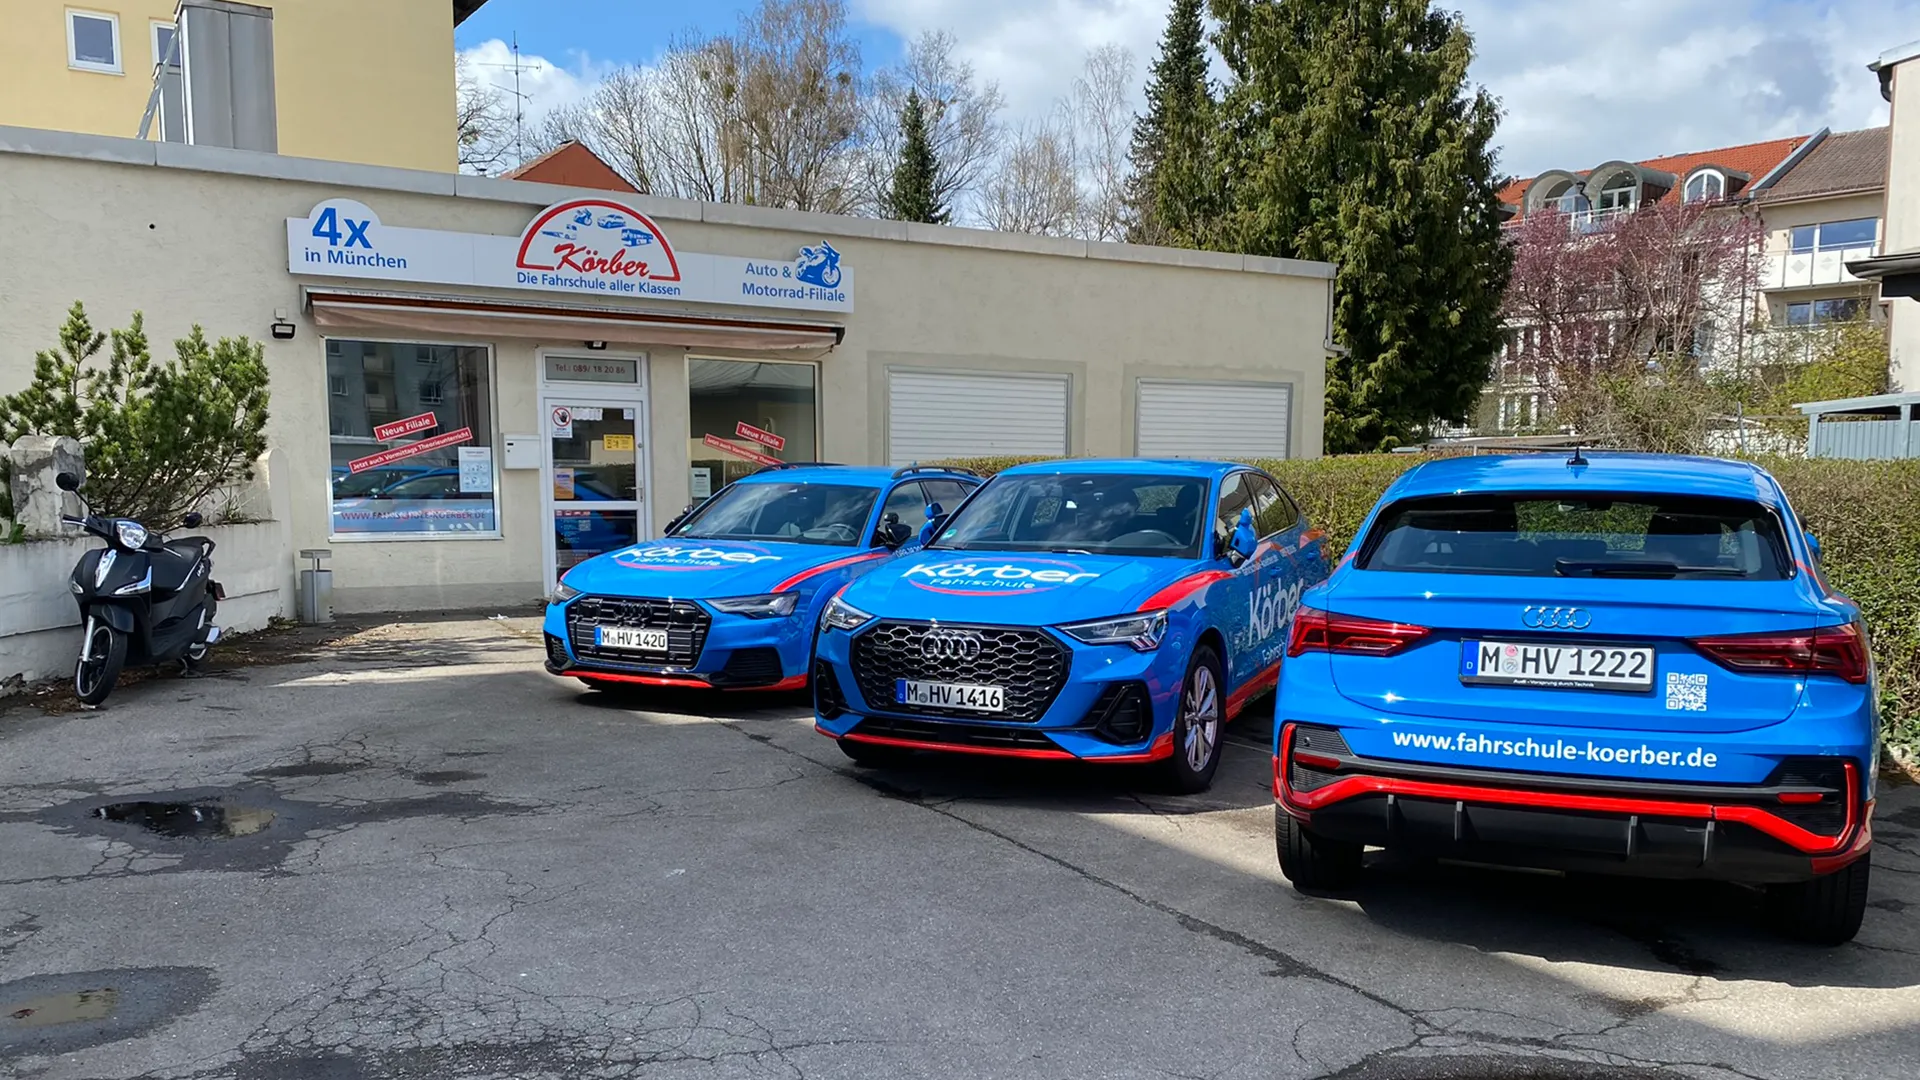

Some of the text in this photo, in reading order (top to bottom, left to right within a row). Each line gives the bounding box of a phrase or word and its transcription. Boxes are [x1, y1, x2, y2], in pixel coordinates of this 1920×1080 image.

[312, 207, 373, 249] 4x
[304, 247, 407, 269] in München
[553, 243, 650, 278] Körber
[745, 262, 792, 279] Auto &
[516, 271, 681, 296] Die Fahrschule aller Klassen
[742, 282, 845, 303] Motorrad-Filiale
[555, 363, 571, 373] Tel.:
[593, 365, 603, 373] 18
[604, 365, 615, 374] 20
[381, 417, 431, 438] Neue Filiale
[740, 427, 780, 447] Neue Filiale
[352, 431, 470, 471] Jetzt auch Vormittags Theorieunterricht
[611, 547, 783, 563] Körber
[631, 557, 721, 567] Fahrschule
[900, 563, 1101, 583] Körber
[930, 577, 1036, 589] Fahrschule
[1249, 578, 1304, 646] Körber
[602, 630, 666, 648] M HV 1420
[1481, 645, 1500, 673] M
[1521, 647, 1562, 675] HV
[1569, 648, 1647, 678] 1222
[907, 682, 918, 701] M
[929, 685, 952, 704] HV
[956, 687, 1001, 708] 1416
[1392, 731, 1718, 767] www.fahrschule-koerber.de
